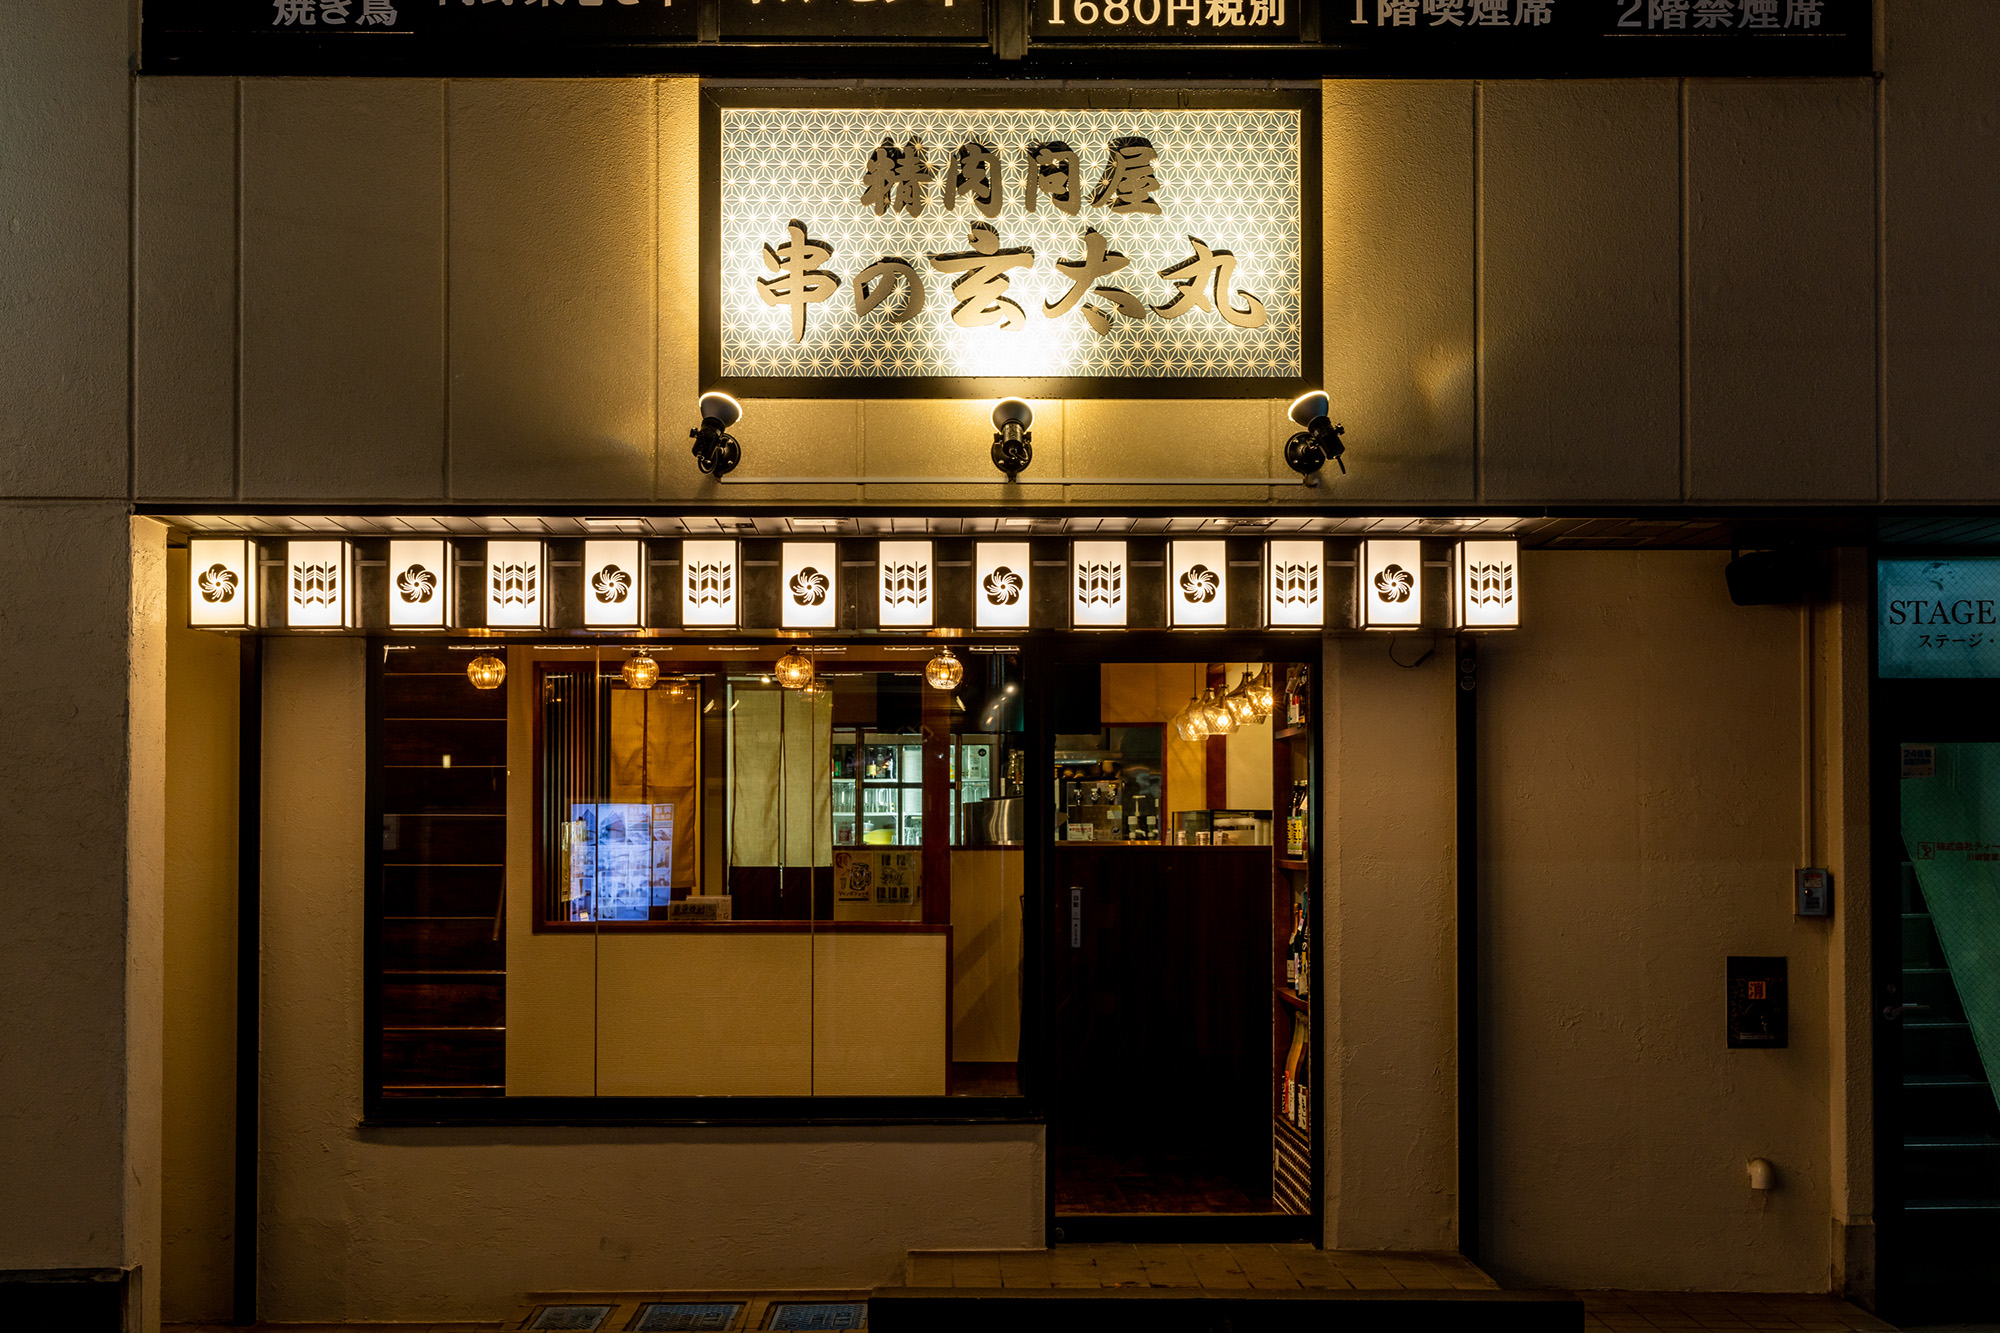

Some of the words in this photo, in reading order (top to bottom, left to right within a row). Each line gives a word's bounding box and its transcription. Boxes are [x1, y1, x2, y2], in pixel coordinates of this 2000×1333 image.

[861, 137, 1162, 218] 精肉問屋
[757, 220, 1267, 344] 串の玄太丸
[1889, 599, 1997, 625] STAGE
